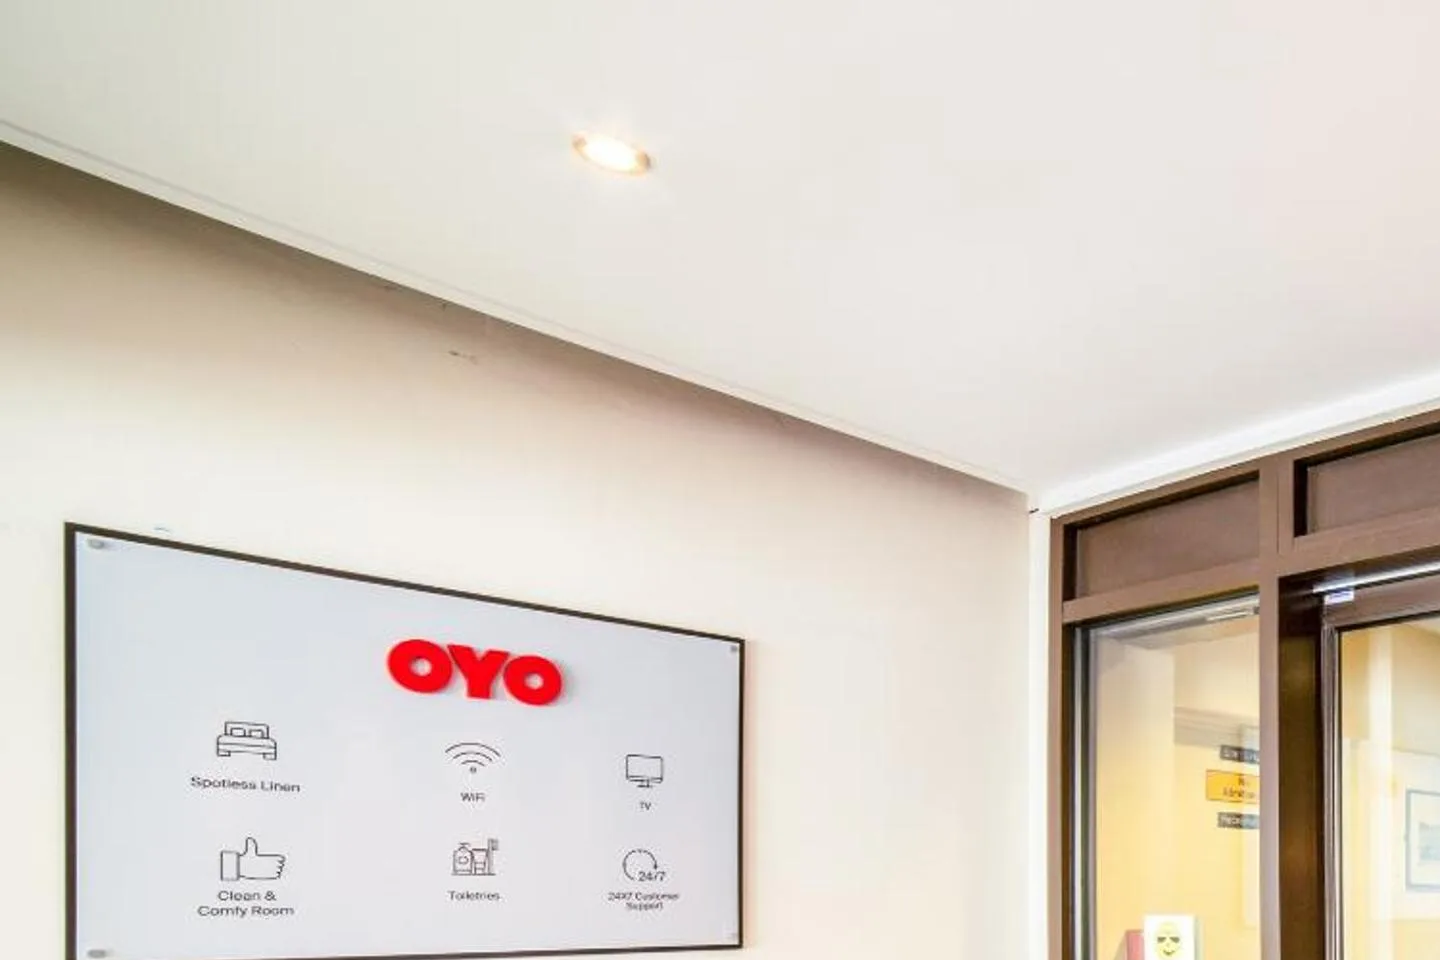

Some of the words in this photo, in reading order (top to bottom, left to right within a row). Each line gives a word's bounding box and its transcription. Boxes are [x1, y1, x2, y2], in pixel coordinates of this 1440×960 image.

[386, 638, 563, 707] OYO
[190, 776, 257, 790] Spotless
[261, 780, 301, 792] Linen
[639, 801, 652, 811] TV
[637, 870, 666, 882] 24/7
[217, 889, 261, 901] Clean
[264, 890, 278, 901] &
[449, 890, 500, 901] Toiletries
[197, 905, 248, 918] Comfy
[251, 905, 295, 916] Room
